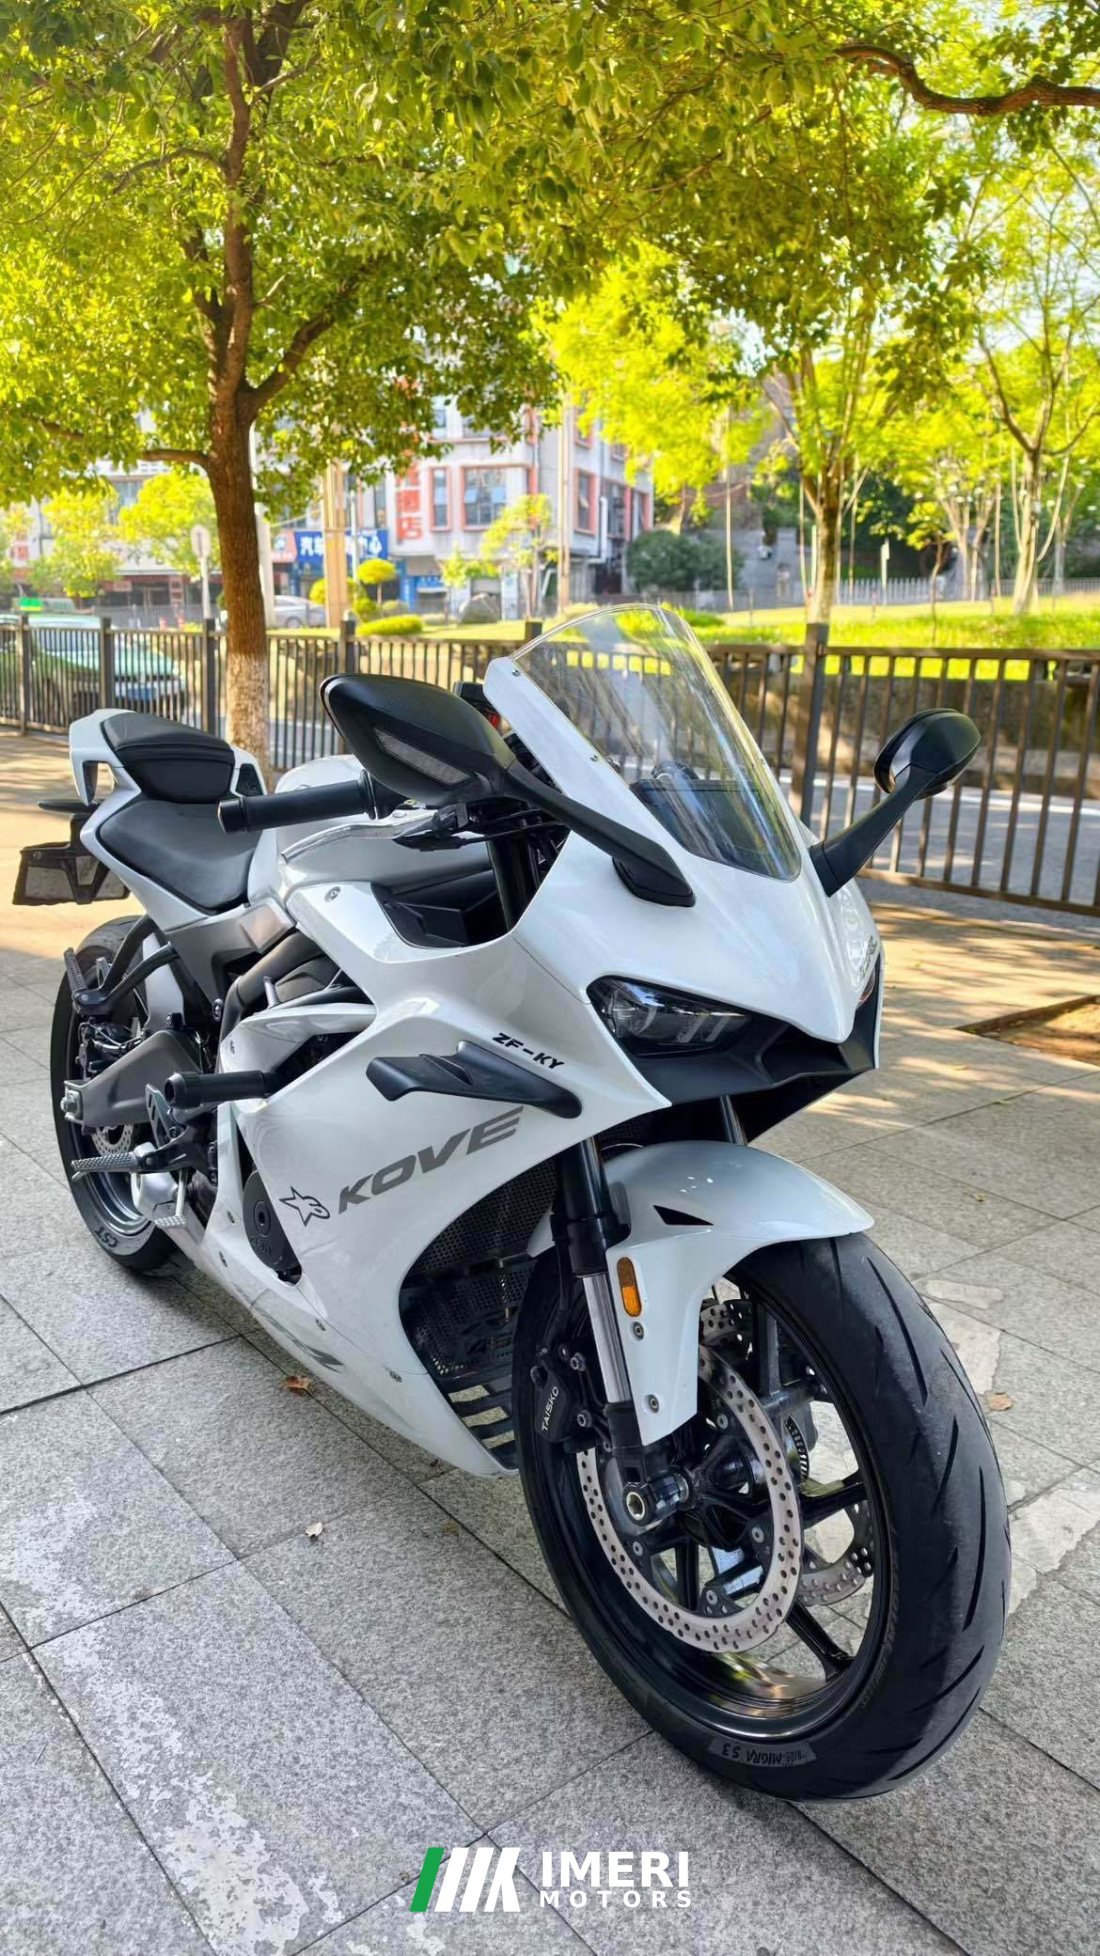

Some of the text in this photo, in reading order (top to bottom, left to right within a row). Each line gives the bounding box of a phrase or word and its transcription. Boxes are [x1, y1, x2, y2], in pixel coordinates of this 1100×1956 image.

[492, 1032, 565, 1070] ZF-KY
[338, 1106, 524, 1214] KOVE
[94, 1226, 119, 1248] CST
[541, 1386, 559, 1432] TAISKO
[721, 1742, 741, 1760] S3
